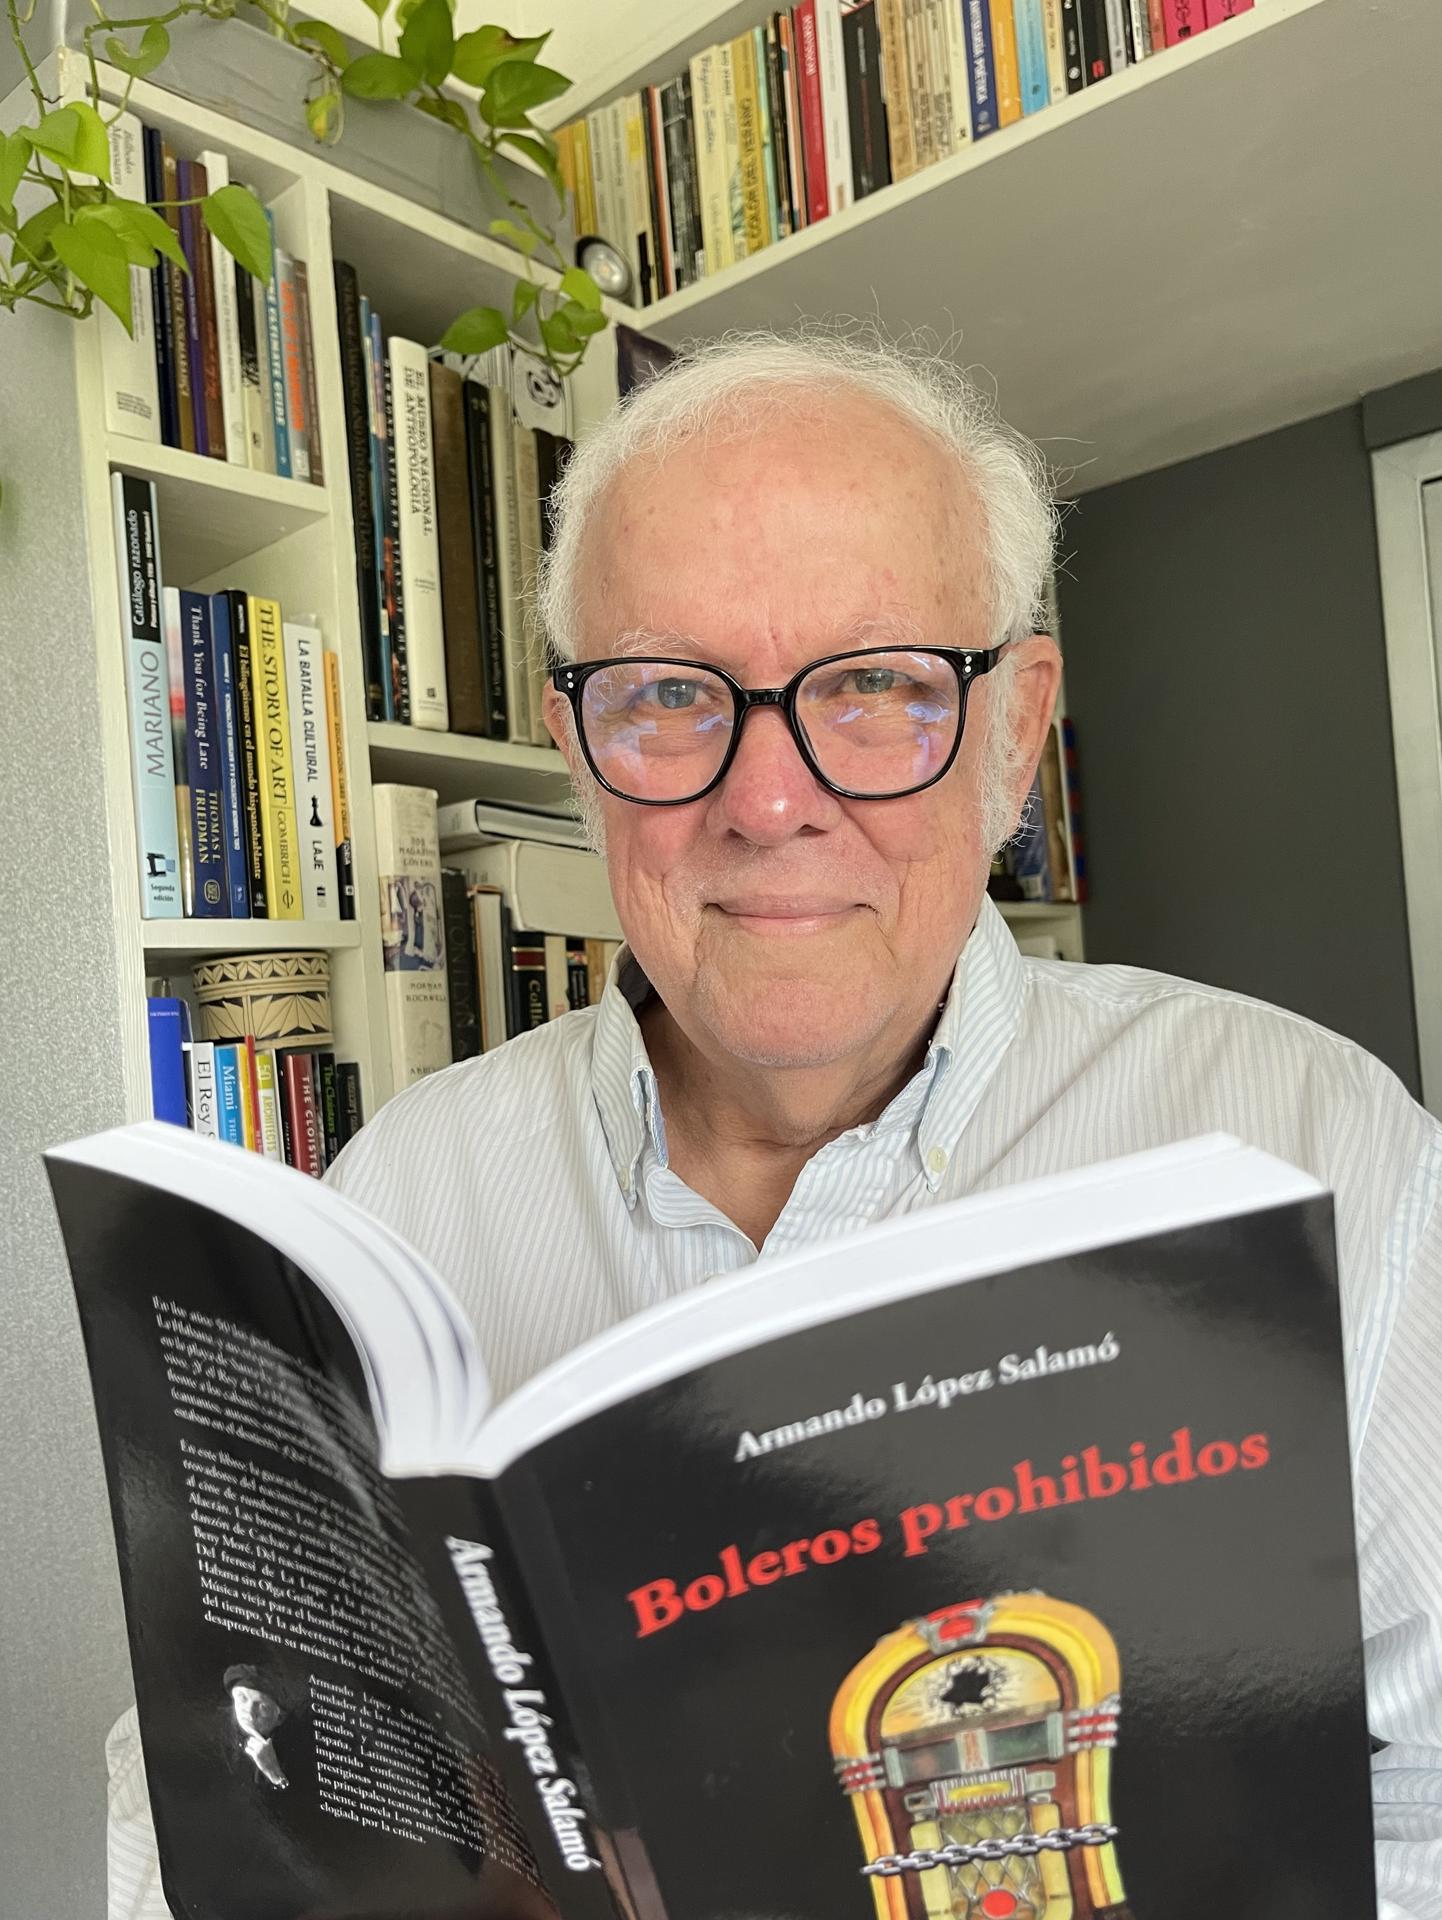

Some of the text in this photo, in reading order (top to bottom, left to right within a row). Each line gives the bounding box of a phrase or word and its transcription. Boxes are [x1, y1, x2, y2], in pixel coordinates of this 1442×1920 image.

[404, 366, 415, 388] DE
[416, 370, 425, 390] EL
[420, 457, 433, 537] NACIONAL
[127, 508, 145, 626] Catálogo razonado
[240, 645, 249, 657] El
[191, 606, 210, 770] Thank You for Being Late
[260, 604, 287, 805] THE STORY OF ART
[298, 639, 319, 782] LA BATALLA CULTURAL
[140, 651, 166, 778] MARIANO
[245, 724, 252, 738] en
[245, 740, 256, 750] el
[246, 751, 258, 790] mundo
[196, 788, 209, 864] FRIEDMAN
[208, 792, 221, 850] THOMAS
[247, 792, 261, 880] hispanohablante
[277, 810, 291, 885] GOMBRICH
[312, 840, 324, 871] LAJE
[197, 1060, 213, 1126] El Rey
[222, 1065, 238, 1111] Miami
[301, 1075, 312, 1105] THE
[323, 1064, 334, 1085] The
[258, 1064, 276, 1153] 50 ARCHITECTS
[323, 1086, 336, 1134] Cloisters
[734, 1332, 1121, 1463] Armando López Salamó
[191, 1509, 229, 1530] danzón
[232, 1521, 245, 1535] de
[248, 1527, 289, 1550] Cachao
[292, 1542, 301, 1555] al
[234, 1505, 253, 1522] Las
[626, 1427, 1271, 1638] Boleros prohibidos
[193, 1524, 219, 1545] Beny
[221, 1533, 253, 1554] Moré.
[256, 1545, 275, 1562] Del
[195, 1542, 327, 1596] Del frenesí de La Lupe
[198, 1558, 239, 1582] Habana
[241, 1575, 256, 1587] sin
[258, 1579, 284, 1597] Olga
[286, 1588, 327, 1612] Guillot.
[200, 1575, 387, 1652] Música vieja para el hombre nuevo.
[202, 1593, 407, 1677] del tiempo. Y la advertencia de Gabriel
[204, 1609, 281, 1643] desaprovechan
[284, 1638, 296, 1648] su
[299, 1642, 337, 1662] música
[340, 1653, 356, 1669] los
[308, 1673, 353, 1696] Armando
[362, 1691, 391, 1710] López
[310, 1687, 356, 1711] Fundador
[359, 1705, 371, 1716] de
[374, 1709, 383, 1721] la
[386, 1717, 416, 1735] revista
[445, 1535, 534, 1685] Armando
[503, 1687, 559, 1776] López
[537, 1773, 602, 1872] Salamó
[311, 1702, 345, 1722] Girasol
[358, 1717, 373, 1730] los
[376, 1727, 410, 1745] artistas
[312, 1719, 354, 1737] artículos
[361, 1734, 366, 1743] y
[374, 1739, 424, 1764] entrevistas
[314, 1730, 351, 1751] España,
[359, 1744, 428, 1778] Latinoamérica
[315, 1744, 363, 1768] impartido
[369, 1765, 429, 1791] conferencias
[316, 1761, 371, 1784] prestigiosas
[375, 1780, 441, 1809] universidades
[317, 1771, 483, 1841] los principales teatros de New York
[319, 1789, 485, 1854] reciente novela Los maricones van
[320, 1801, 425, 1843] elogiada por la crítica.
